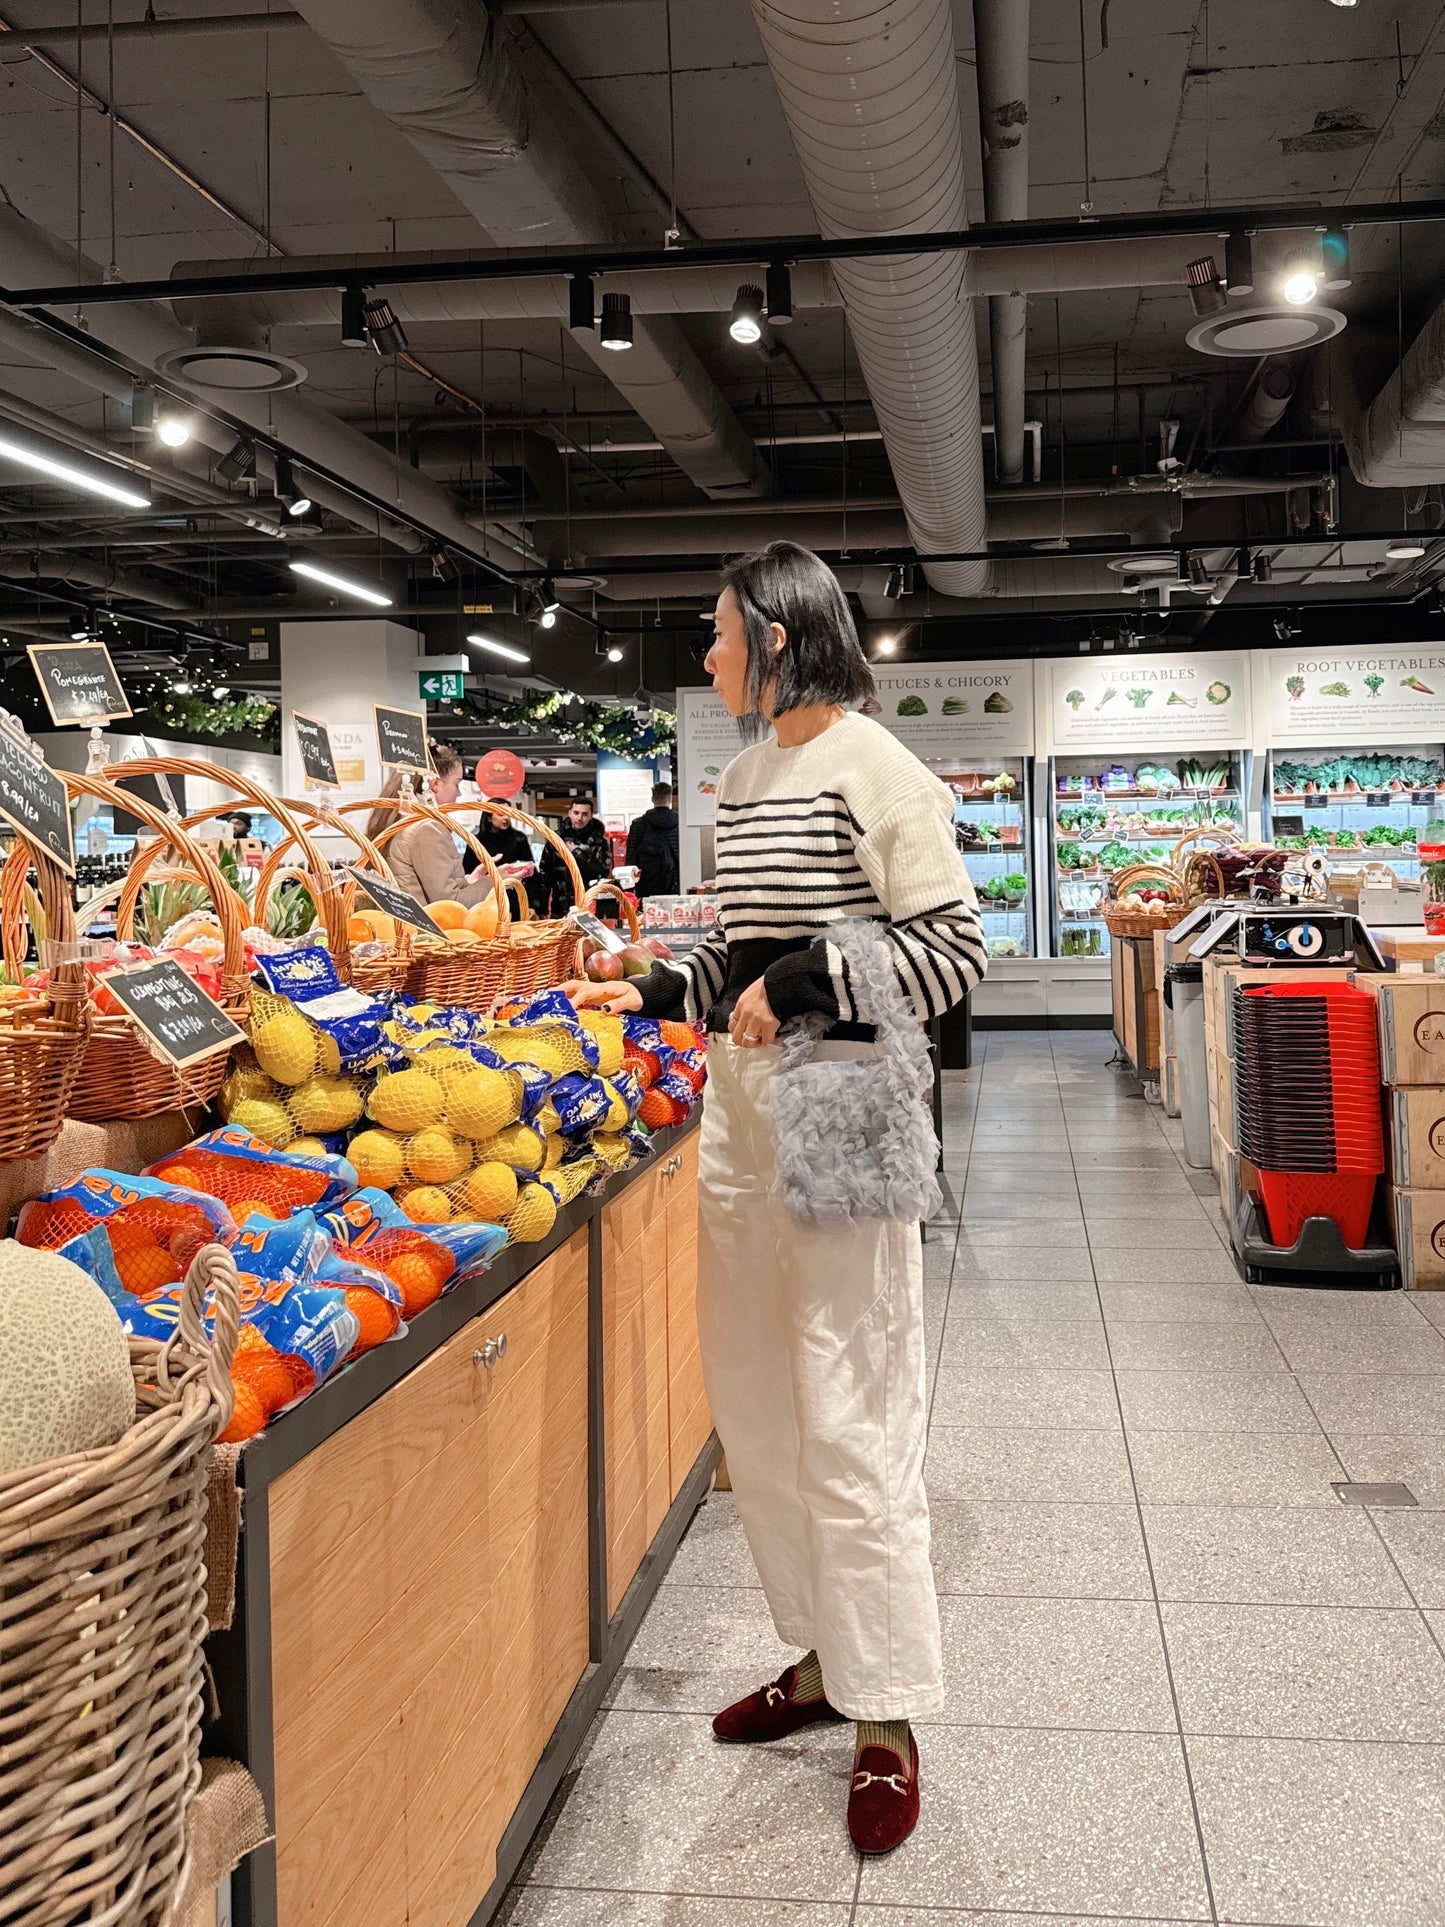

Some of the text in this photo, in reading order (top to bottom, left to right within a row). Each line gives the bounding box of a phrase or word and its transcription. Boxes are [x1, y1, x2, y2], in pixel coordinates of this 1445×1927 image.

[1297, 657, 1445, 673] ROOT VEGETABLES
[934, 678, 943, 688] &
[948, 675, 1012, 688] CHICORY
[1100, 668, 1195, 682] VEGETABLES
[689, 710, 707, 719] ALL
[566, 1090, 604, 1118] DARLING
